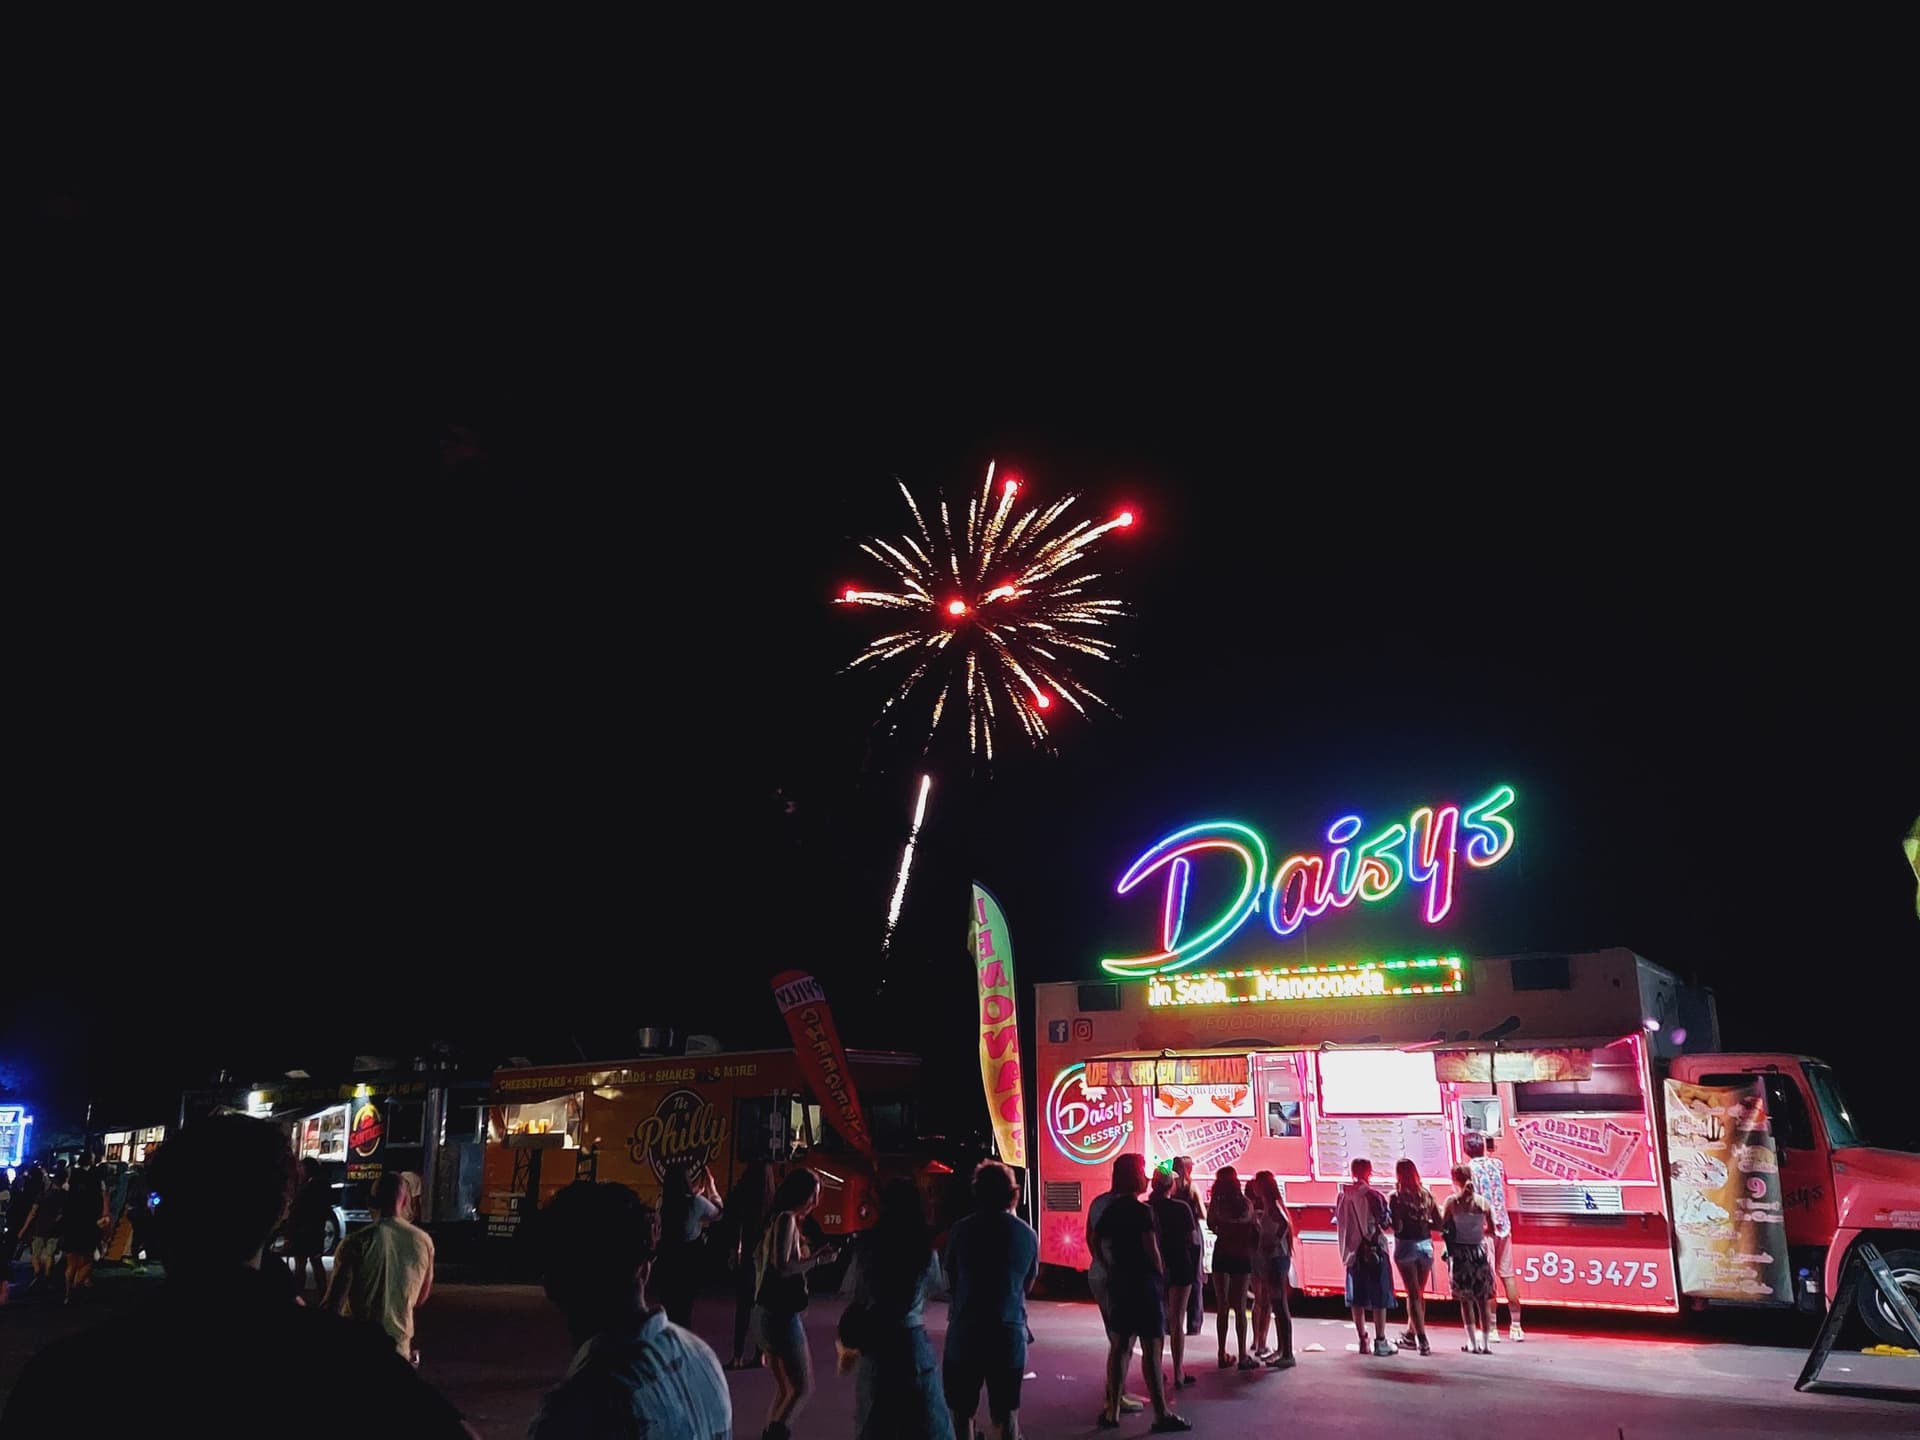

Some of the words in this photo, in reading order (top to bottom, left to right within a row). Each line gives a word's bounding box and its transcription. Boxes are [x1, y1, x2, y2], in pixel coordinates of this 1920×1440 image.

[1099, 785, 1518, 977] Daisys
[1176, 978, 1227, 1002] Soda
[500, 1076, 568, 1090] CHEESESTEAKS
[655, 1069, 697, 1082] SHAKES
[1056, 1097, 1133, 1135] Daisys
[631, 1103, 729, 1164] Philly
[1082, 1120, 1134, 1147] DESSERTS
[1186, 1125, 1214, 1143] PICK
[1215, 1119, 1231, 1134] UP
[1544, 1118, 1602, 1144] ORDER
[1206, 1147, 1242, 1173] HERE
[1531, 1154, 1579, 1182] HERE
